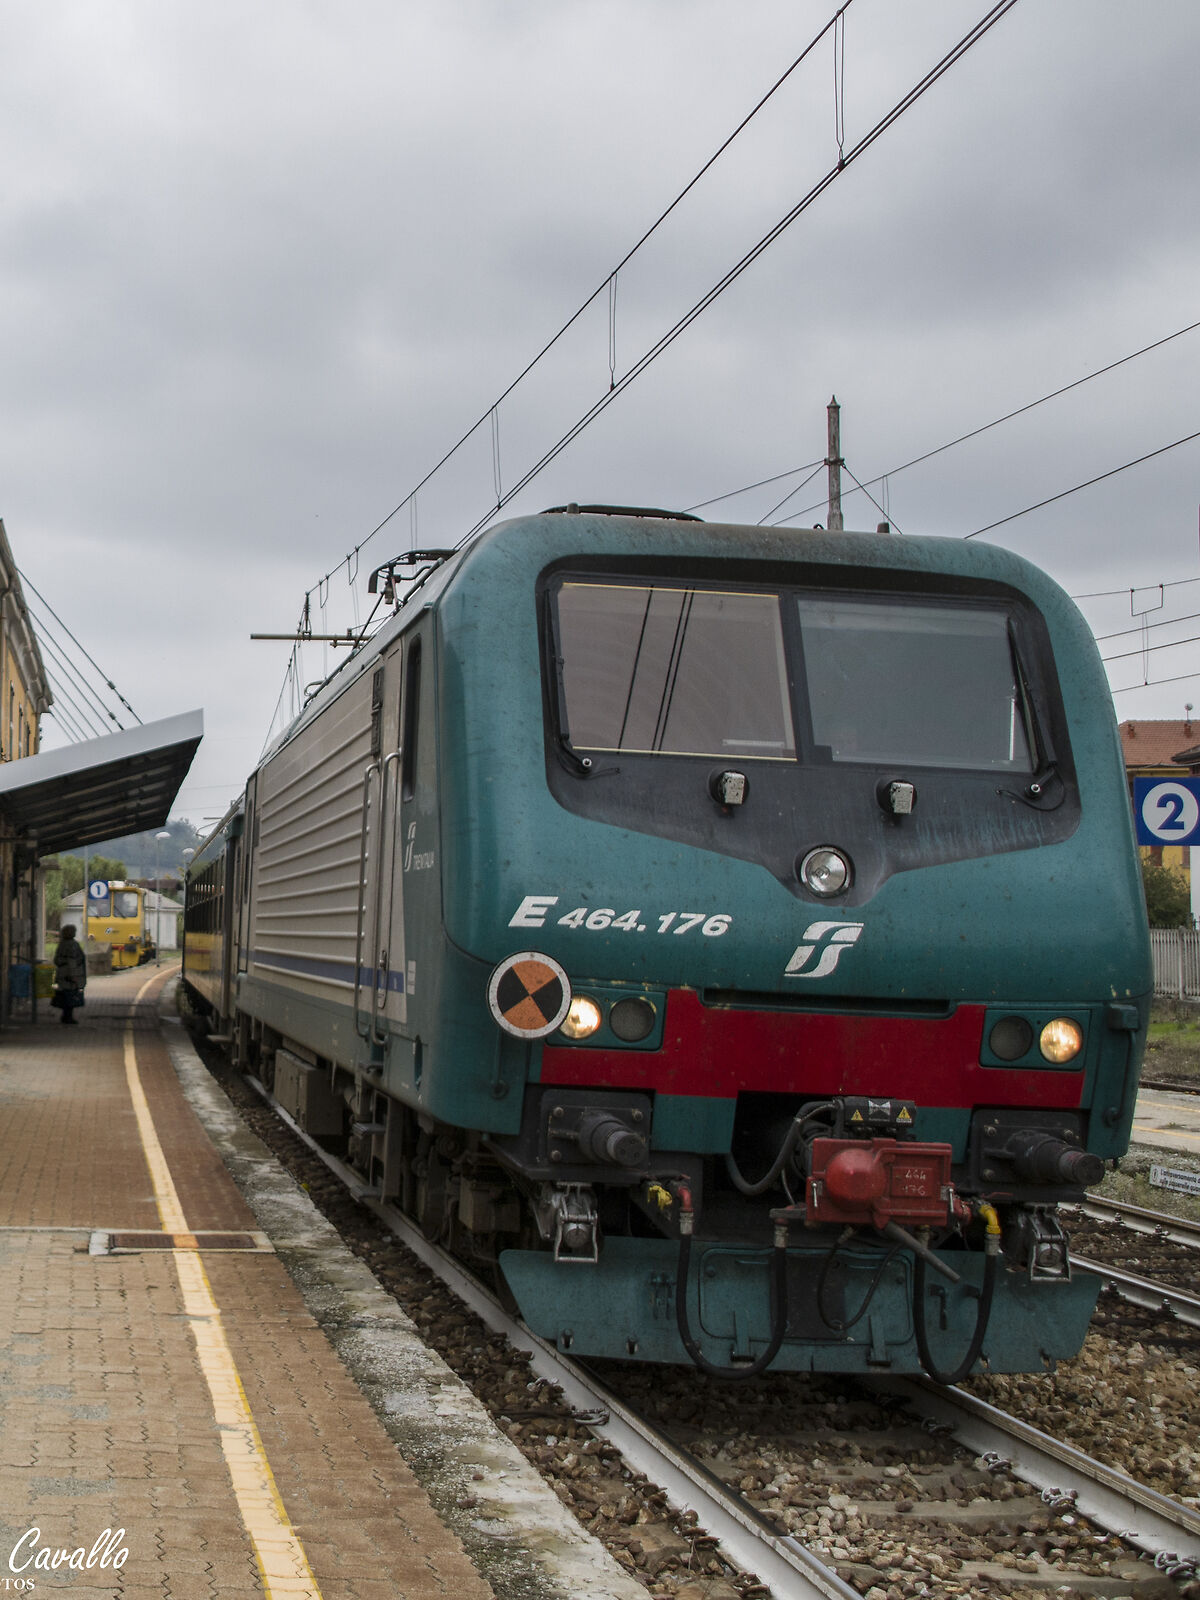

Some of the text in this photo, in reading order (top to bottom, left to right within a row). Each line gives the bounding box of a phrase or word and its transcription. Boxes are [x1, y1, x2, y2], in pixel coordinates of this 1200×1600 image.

[1156, 793, 1185, 830] 2
[96, 885, 101, 896] 1
[508, 895, 559, 928] E
